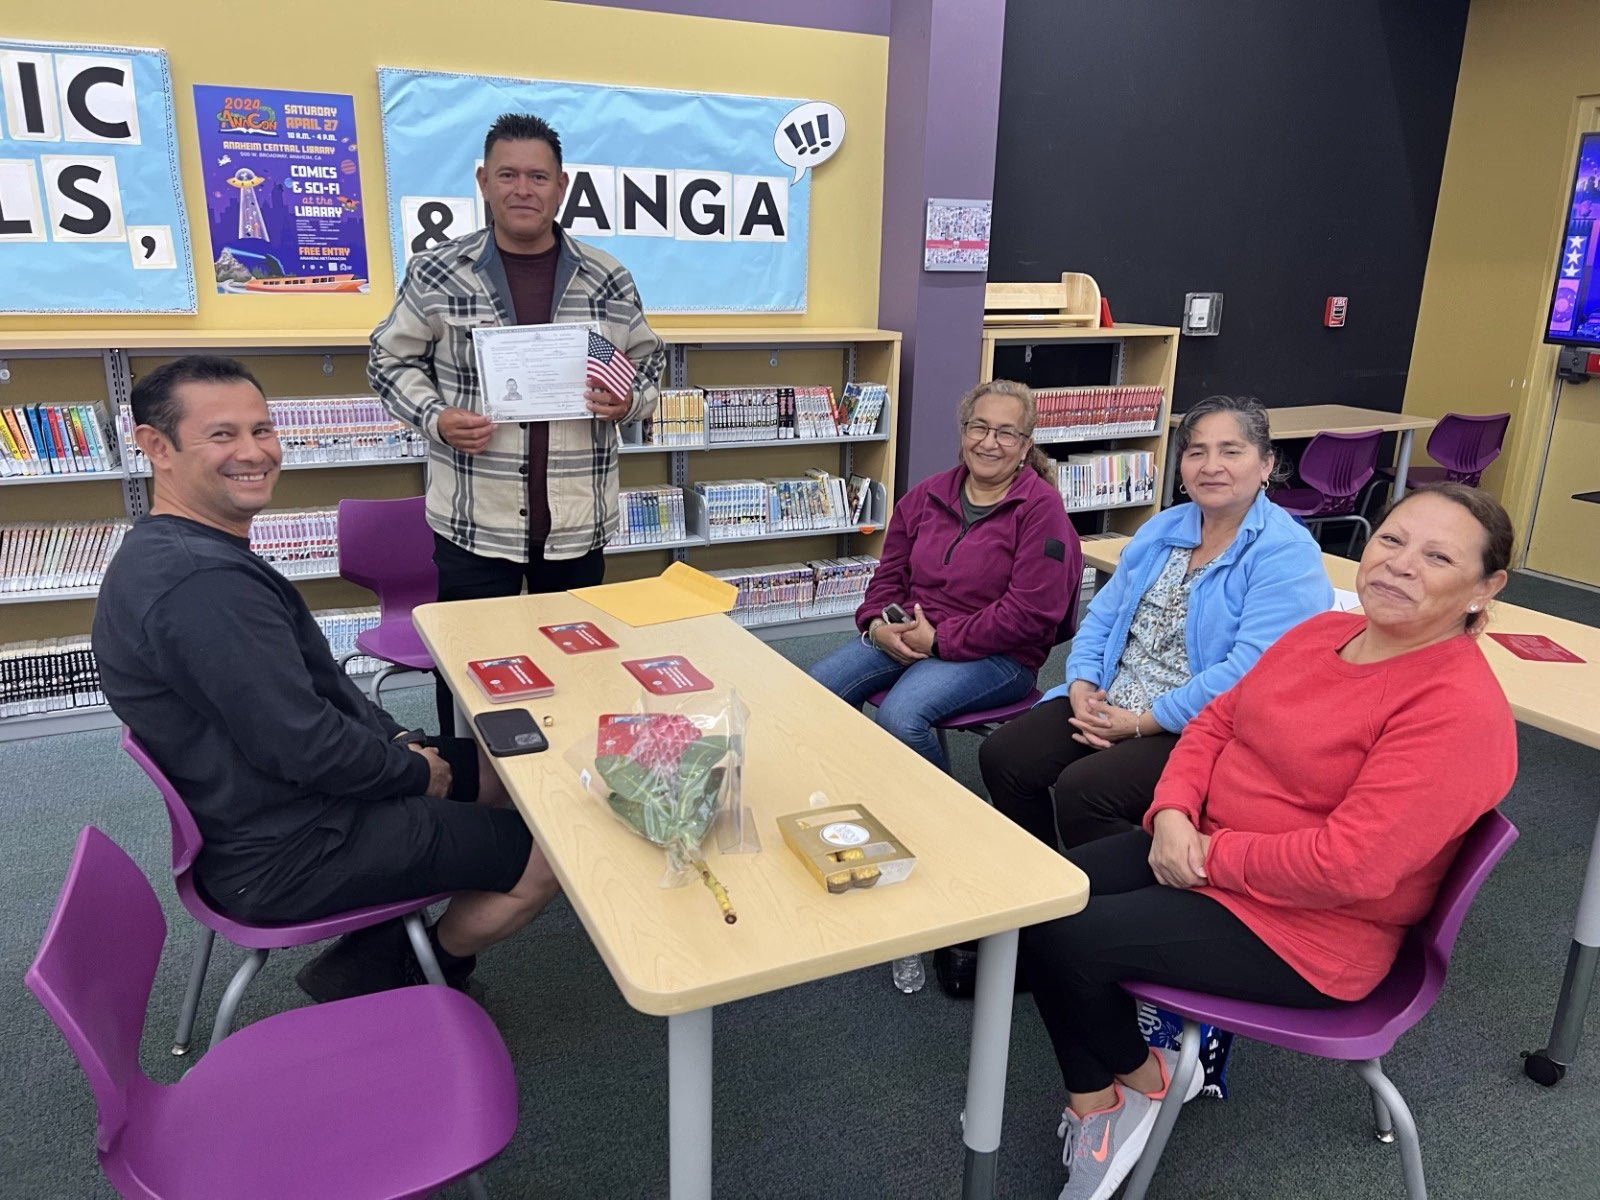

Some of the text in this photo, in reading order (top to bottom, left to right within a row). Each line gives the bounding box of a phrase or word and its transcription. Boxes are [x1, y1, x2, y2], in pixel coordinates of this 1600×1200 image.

[18, 62, 131, 139] IC
[225, 97, 261, 111] 2024
[284, 104, 338, 117] SATURDAY
[285, 116, 338, 131] APRIL 27
[784, 114, 831, 156] !!!
[223, 141, 336, 155] ANAHEIM CENTRAL LIBRARY
[291, 165, 338, 179] COMICS
[292, 181, 340, 195] & SCI-FI
[302, 196, 333, 205] at the
[294, 205, 343, 218] LIBRARY
[410, 201, 455, 254] &
[486, 171, 785, 238] ANGA
[299, 246, 350, 257] FREE ENTRY
